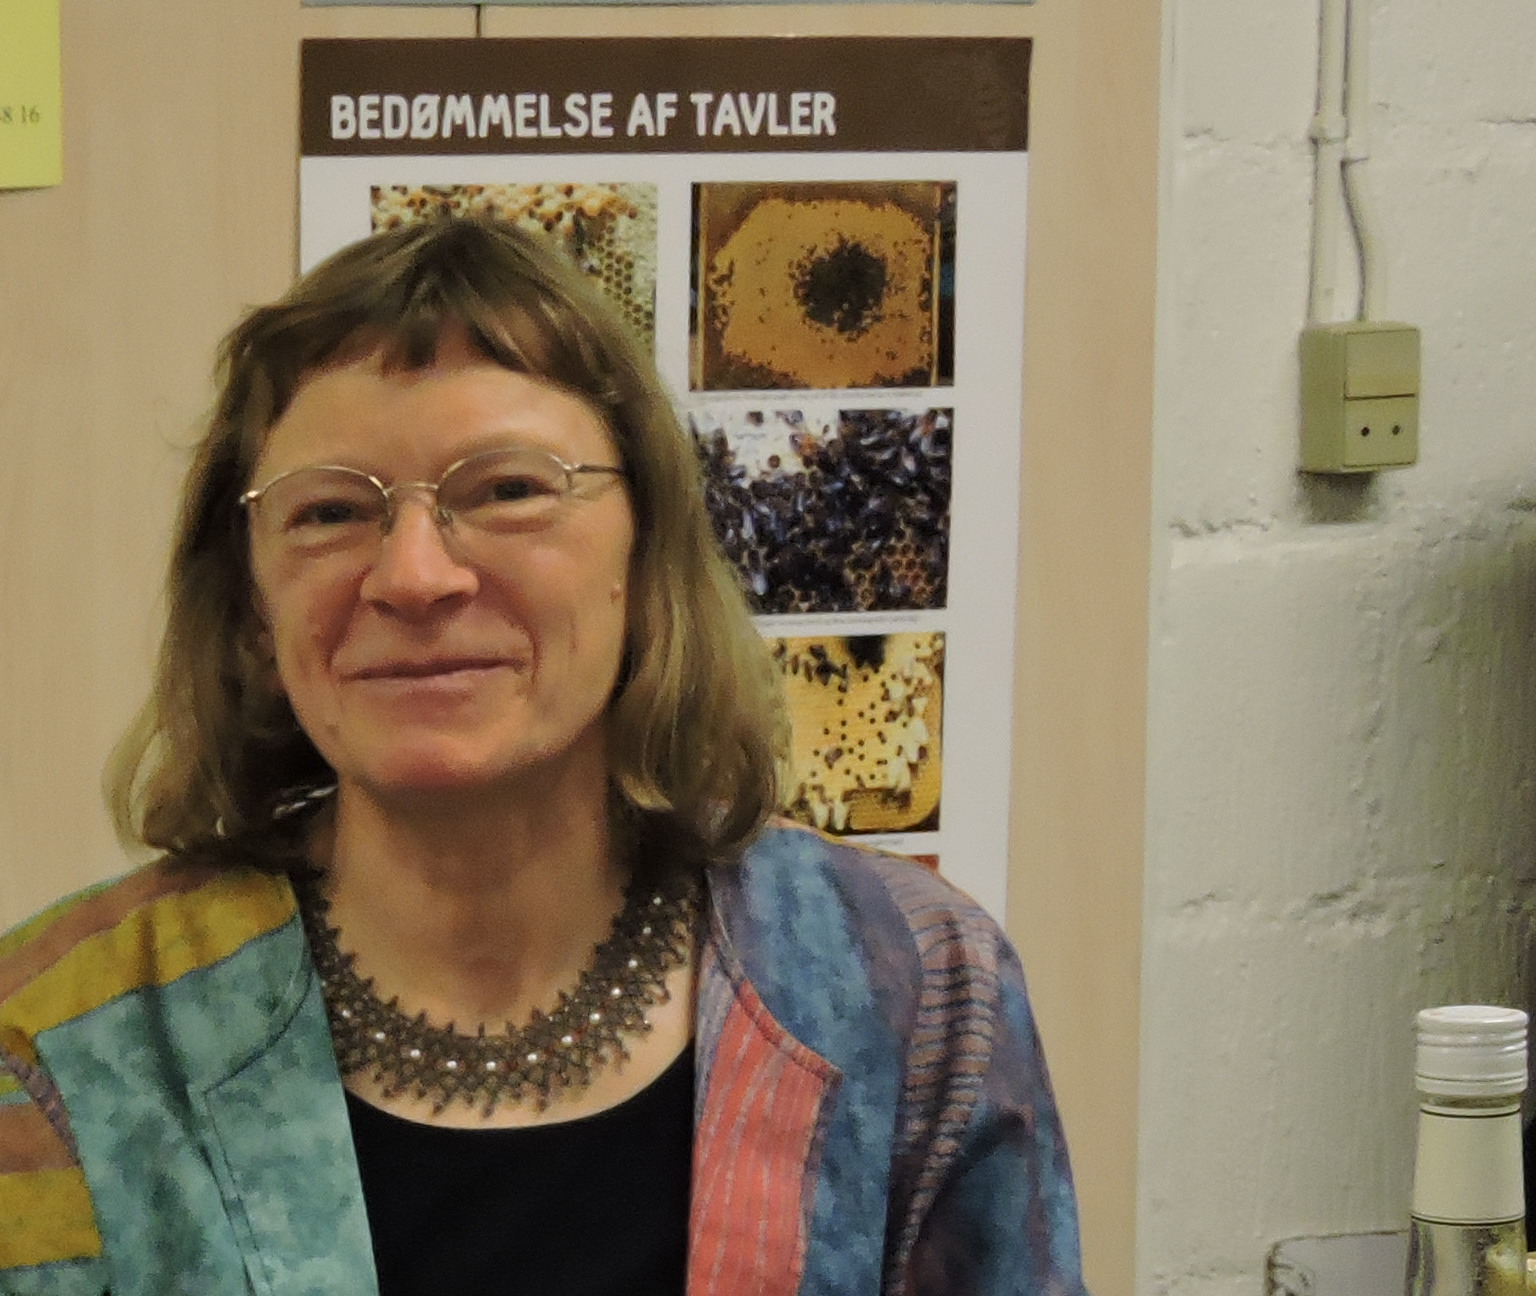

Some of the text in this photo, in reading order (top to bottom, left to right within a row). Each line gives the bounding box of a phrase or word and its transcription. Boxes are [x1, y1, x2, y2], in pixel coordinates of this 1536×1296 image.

[19, 104, 41, 125] 16
[329, 90, 838, 140] BEDØMMELSE AF TAVLER
